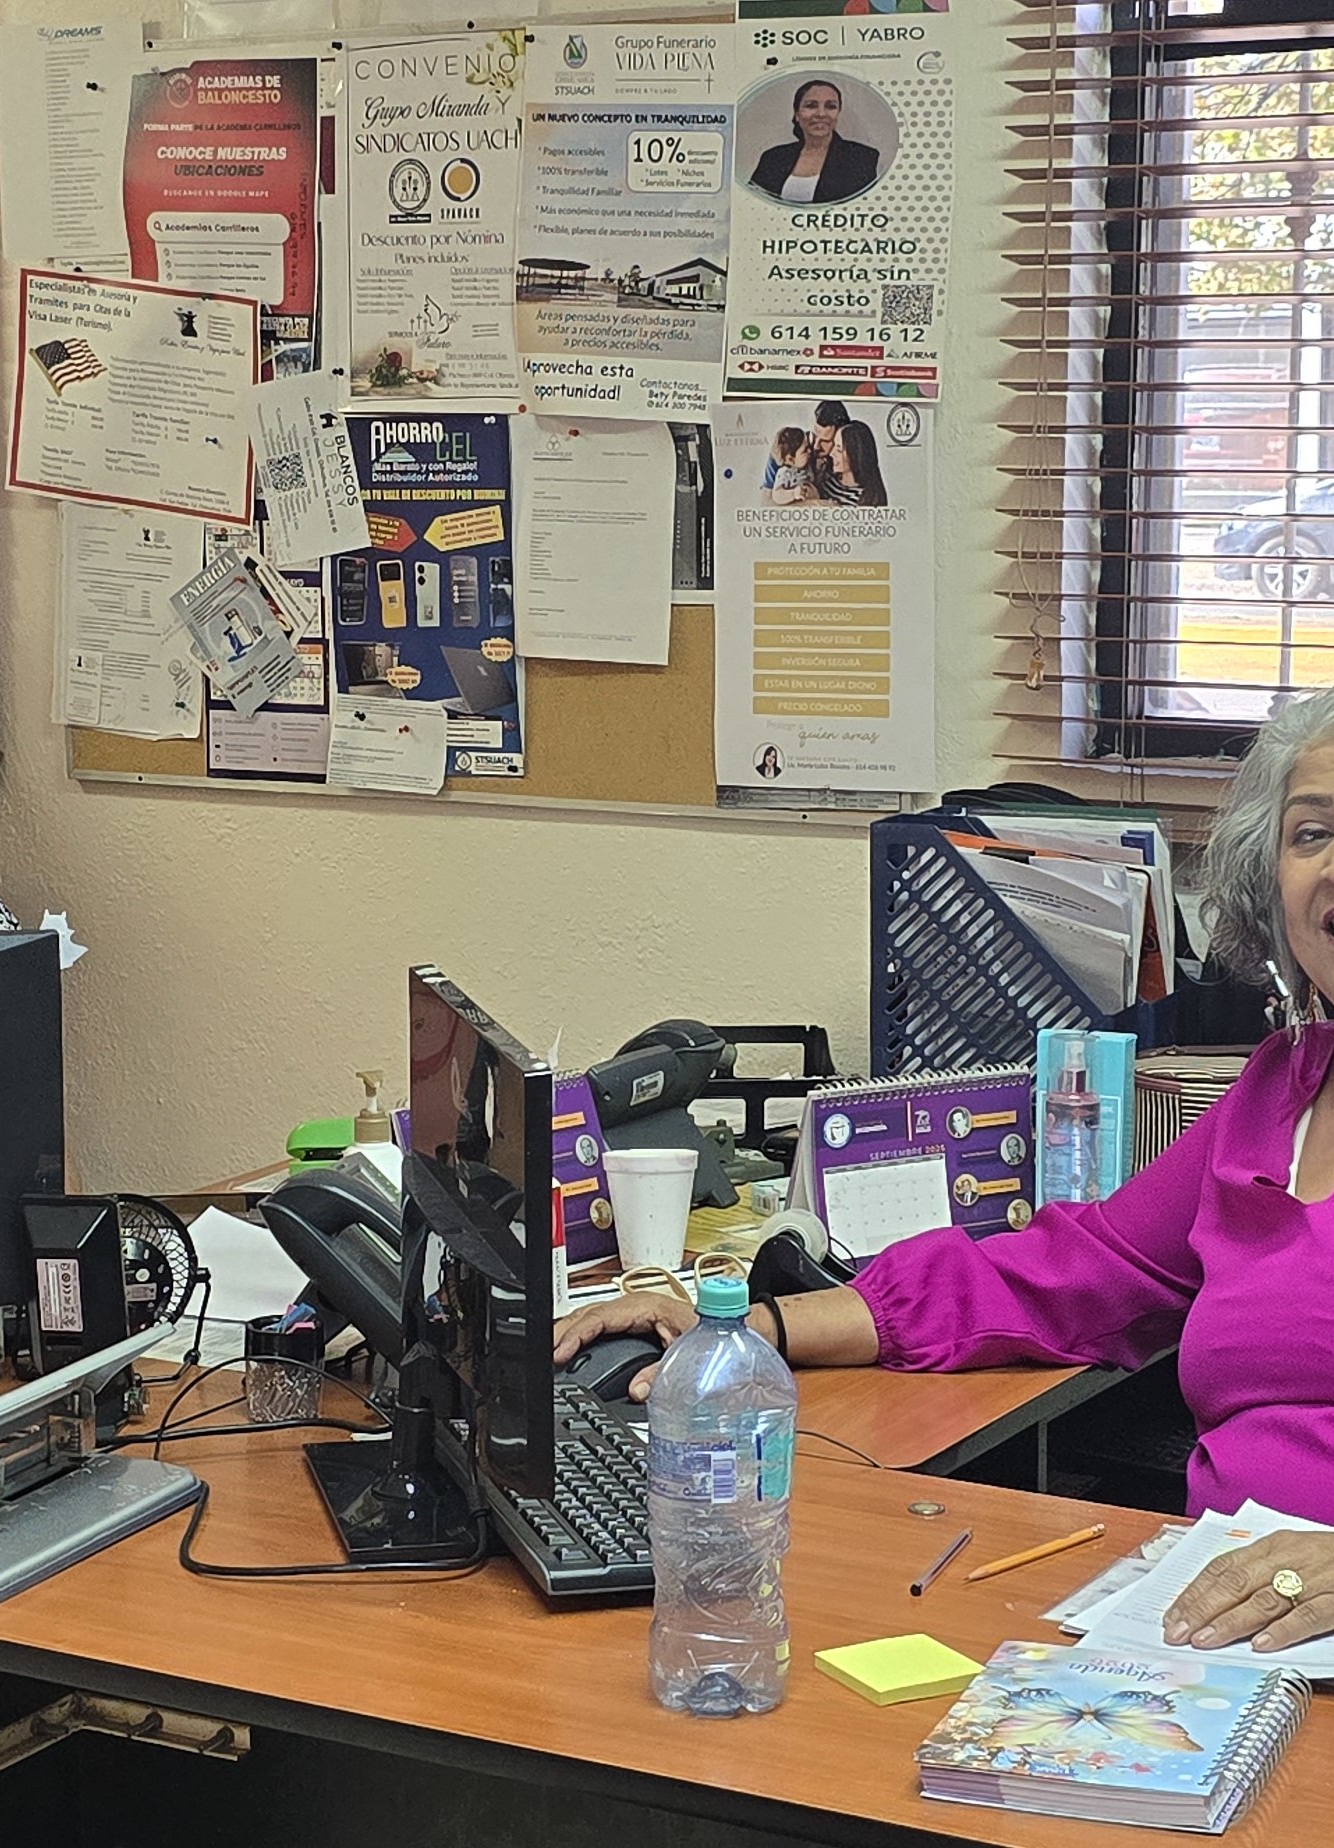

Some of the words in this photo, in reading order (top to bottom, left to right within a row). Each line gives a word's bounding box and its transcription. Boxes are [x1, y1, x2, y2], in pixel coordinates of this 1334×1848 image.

[781, 29, 829, 46] SOC
[857, 26, 925, 42] YABRO
[615, 35, 653, 53] Grupo
[656, 35, 717, 49] Funerario
[355, 53, 516, 80] CONVENIO
[616, 52, 656, 71] VIDA
[664, 52, 715, 72] PLENA
[198, 76, 263, 89] ACADEMIAS
[265, 75, 281, 88] DE
[197, 90, 281, 104] BALONCESTO
[555, 86, 595, 96] STSUACH
[362, 96, 412, 129] Grupo
[417, 92, 490, 119] Miranda
[495, 95, 512, 115] Y
[532, 113, 545, 122] UN
[548, 113, 579, 123] NUEVO
[582, 113, 632, 124] CONCEPTO
[635, 114, 648, 124] EN
[651, 114, 727, 126] TRANQUILIDAD
[355, 131, 460, 154] SINDICATOS
[466, 129, 518, 151] UACH
[157, 146, 214, 160] CONOCE
[217, 146, 287, 160] NUESTRAS
[633, 137, 686, 164] 10%
[174, 164, 264, 178] UBICACIONES
[542, 186, 590, 197] Tranquilidad
[591, 187, 623, 197] Familiar
[601, 210, 616, 219] que
[791, 210, 889, 228] CRÉDITO
[598, 227, 608, 236] de
[361, 233, 427, 247] Descuento
[430, 235, 452, 249] por
[455, 229, 505, 245] Nómina
[762, 239, 917, 255] HIPOTECARIO
[767, 264, 868, 281] Asesoría
[29, 279, 85, 295] Especialistas
[807, 293, 871, 307] costo
[28, 310, 48, 321] Visa
[72, 302, 91, 313] para
[93, 303, 111, 316] Citas
[113, 306, 122, 317] de
[564, 312, 610, 325] pensadas
[673, 318, 696, 329] para
[537, 324, 569, 337] ayudar
[578, 325, 637, 338] reconfortar
[638, 327, 648, 339] la
[770, 326, 811, 341] 614
[818, 326, 858, 342] 159
[866, 327, 892, 342] 16
[899, 328, 925, 343] 12
[571, 338, 608, 350] precios
[600, 363, 634, 378] esta
[534, 384, 621, 401] oportunidad!
[370, 421, 444, 461] AHORRO
[436, 432, 478, 461] CEL
[322, 438, 348, 507] JESSY
[334, 434, 359, 507] BLANCOS
[428, 463, 444, 471] con
[372, 472, 426, 482] Distribuidor
[427, 472, 479, 482] Autorizado
[736, 509, 809, 522] BENEFICIOS
[812, 509, 828, 521] DE
[831, 509, 907, 522] CONTRATAR
[743, 526, 762, 538] UN
[765, 526, 822, 538] SERVICIO
[824, 525, 897, 538] FUNERARIO
[788, 542, 798, 554] A
[799, 542, 851, 555] FUTURO
[802, 590, 839, 599] AHORRO
[790, 612, 852, 622] TRANQUILIDAD
[827, 658, 861, 667] SEGURA
[764, 679, 790, 688] ESTAR
[791, 680, 803, 689] EN
[805, 680, 817, 689] UN
[819, 680, 846, 690] LUGAR
[848, 681, 877, 691] DIGNO
[778, 702, 808, 711] PRECIO
[809, 702, 863, 713] CONGELADO
[870, 1147, 922, 1160] SEPTIEMBRE
